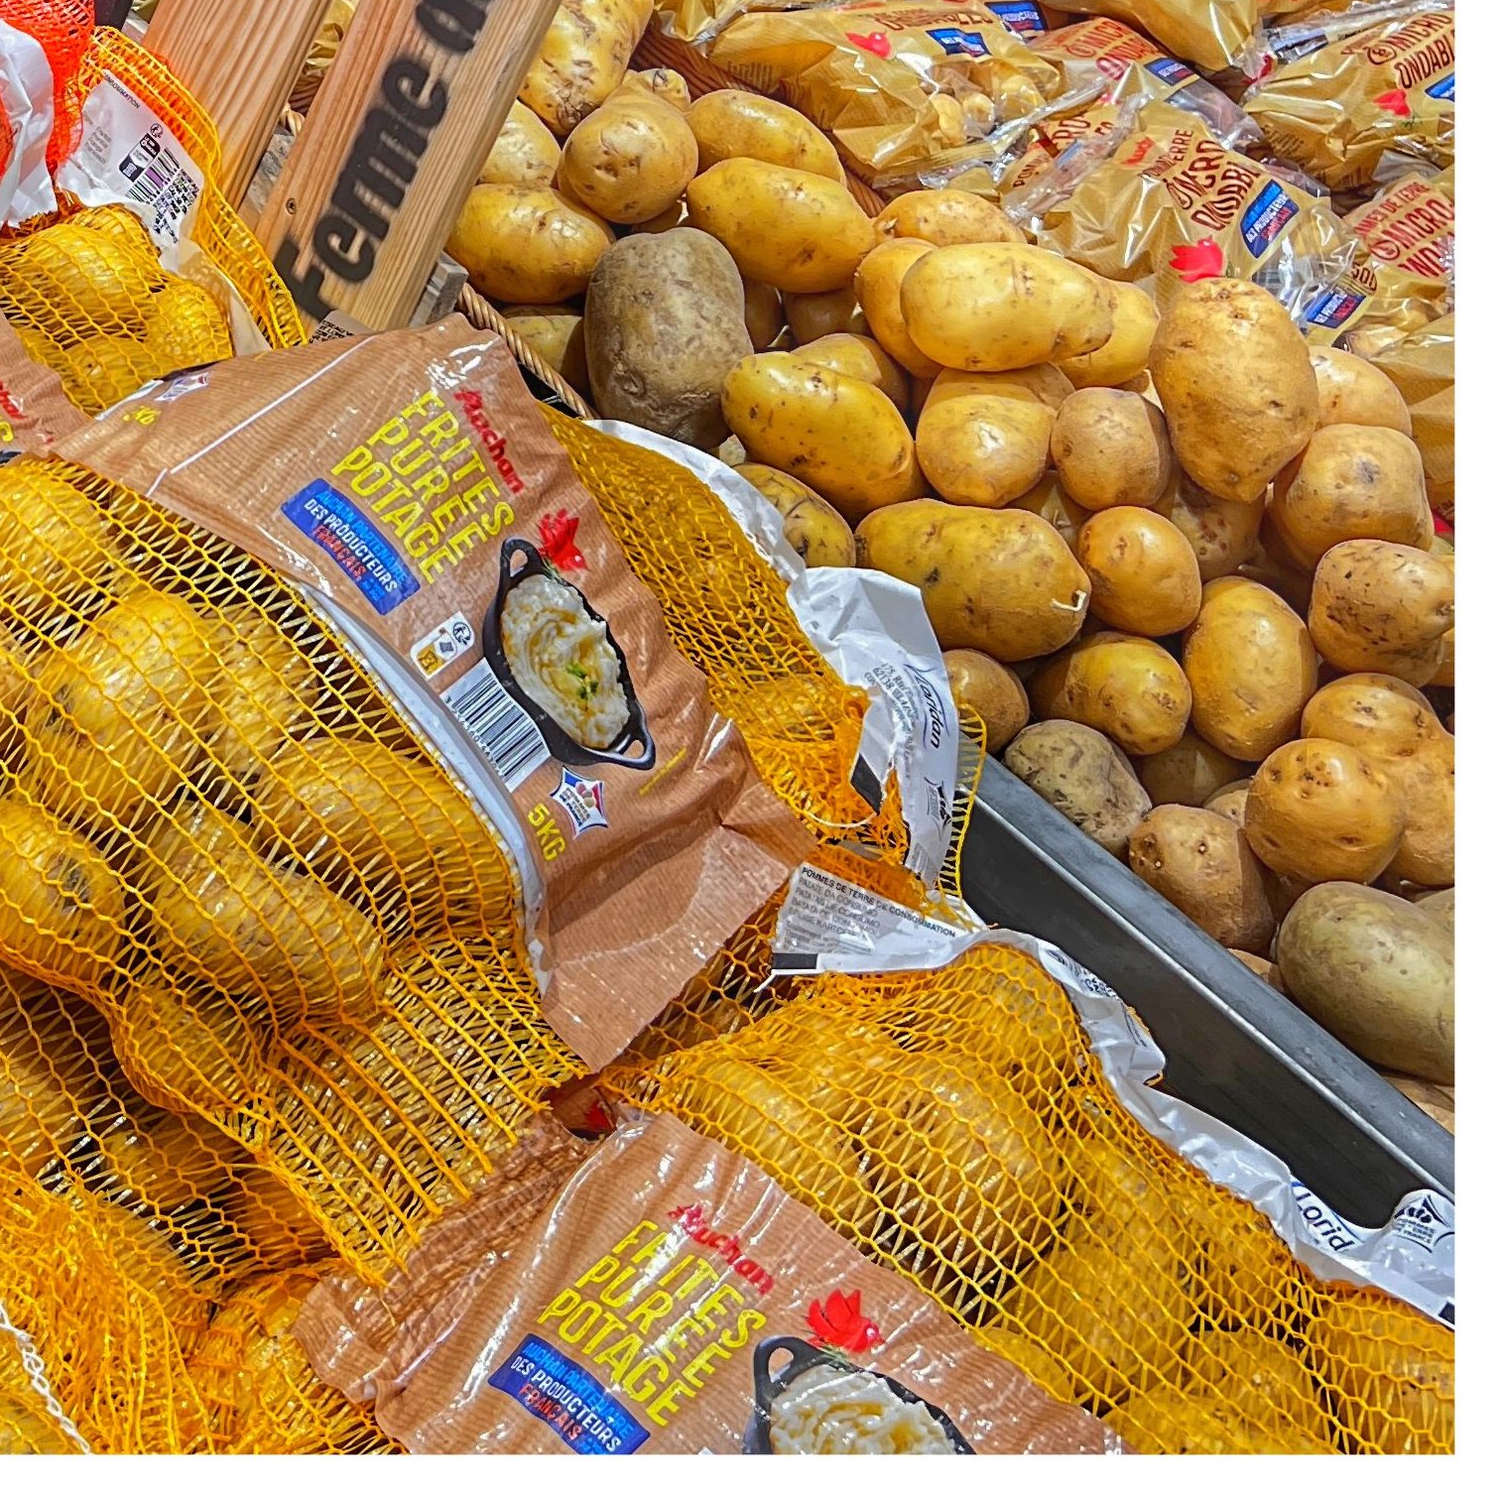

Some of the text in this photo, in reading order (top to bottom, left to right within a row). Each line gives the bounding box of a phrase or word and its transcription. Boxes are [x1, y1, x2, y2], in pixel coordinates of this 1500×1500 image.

[275, 54, 448, 320] Ferme
[399, 390, 514, 538] FRITES
[453, 389, 525, 494] Auchan
[304, 499, 397, 592] DES PRODUCTEURS
[331, 443, 446, 585] POTAGE
[913, 672, 946, 750] Loridan
[528, 802, 566, 862] 5KG
[802, 866, 835, 889] POMMES
[836, 881, 848, 894] DE
[849, 887, 875, 906] TERRE
[888, 904, 956, 938] CONSOMMATION
[611, 1218, 769, 1353] FRITES
[667, 1203, 776, 1296] Auchan
[510, 1355, 622, 1453] DES PRODUCTEURS
[522, 1342, 634, 1439] AUCHAN PARTENAIRE
[537, 1288, 684, 1428] POTAGE
